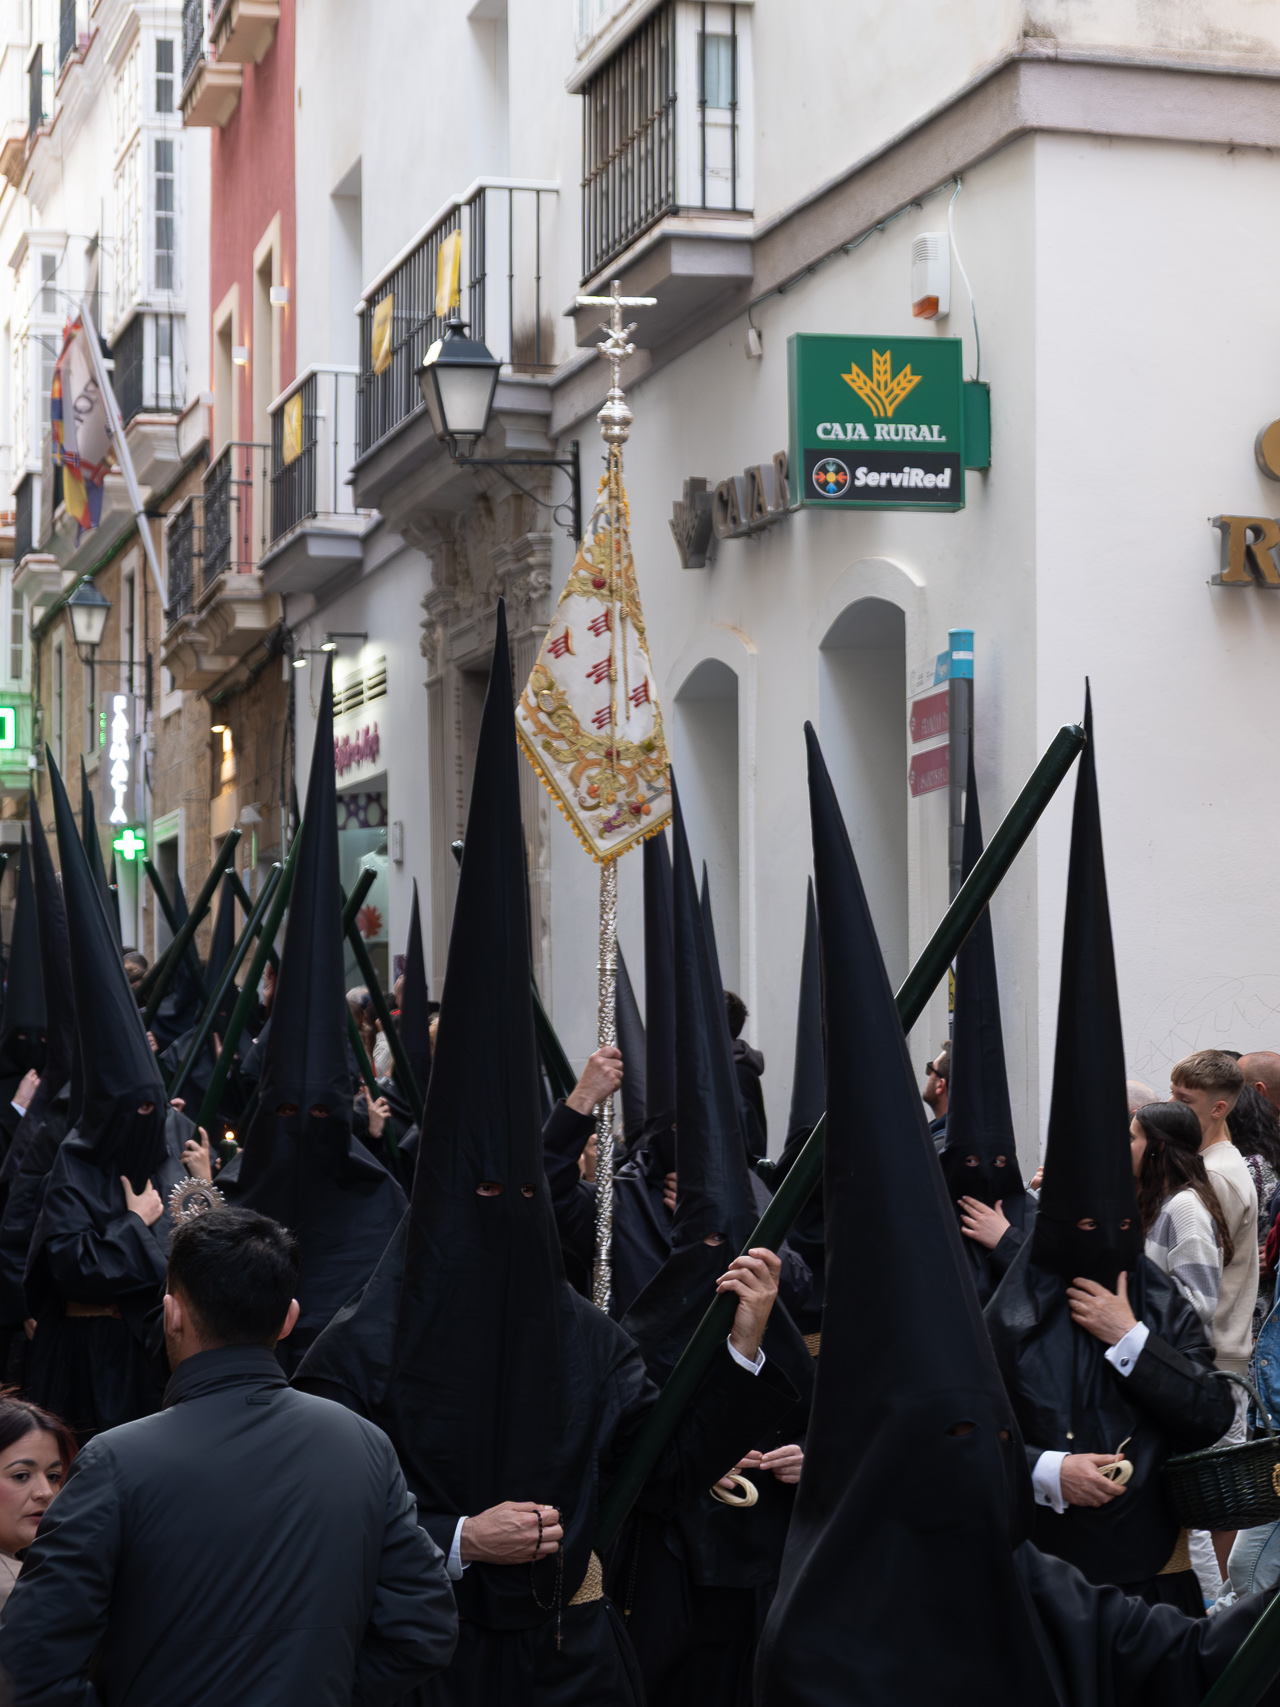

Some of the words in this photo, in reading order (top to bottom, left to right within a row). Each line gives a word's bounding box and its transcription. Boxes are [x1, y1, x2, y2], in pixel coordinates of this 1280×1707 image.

[816, 422, 870, 442] CAJA
[873, 423, 947, 442] RURAL
[854, 466, 951, 489] ServiRed
